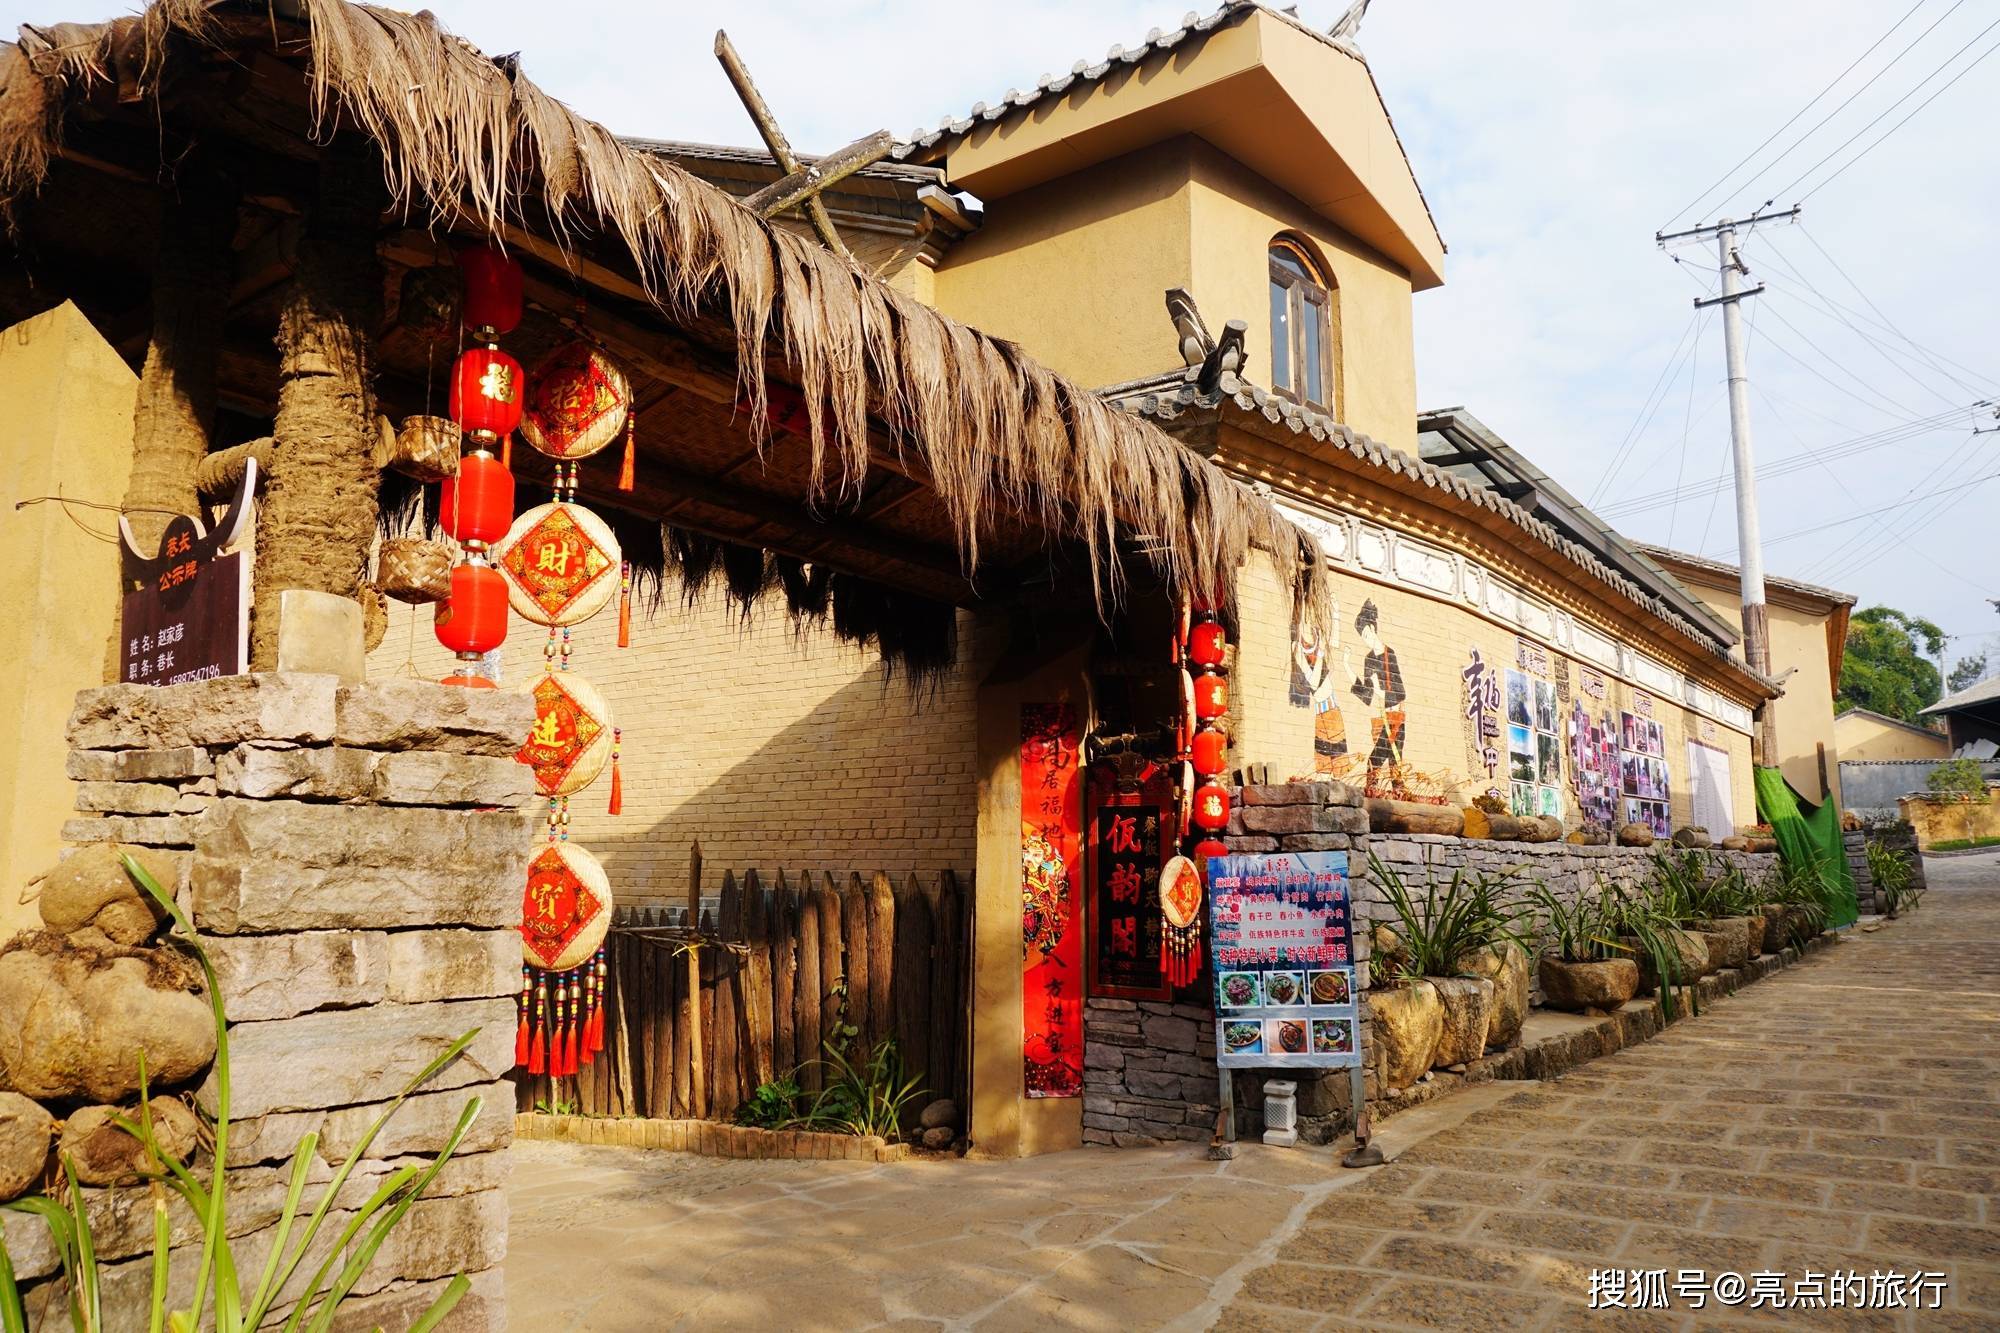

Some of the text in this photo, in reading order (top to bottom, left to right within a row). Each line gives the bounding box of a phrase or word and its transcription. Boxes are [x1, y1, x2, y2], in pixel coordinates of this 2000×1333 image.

[166, 531, 192, 557] 巷长
[535, 540, 572, 576] 財
[159, 560, 198, 591] 公示牌
